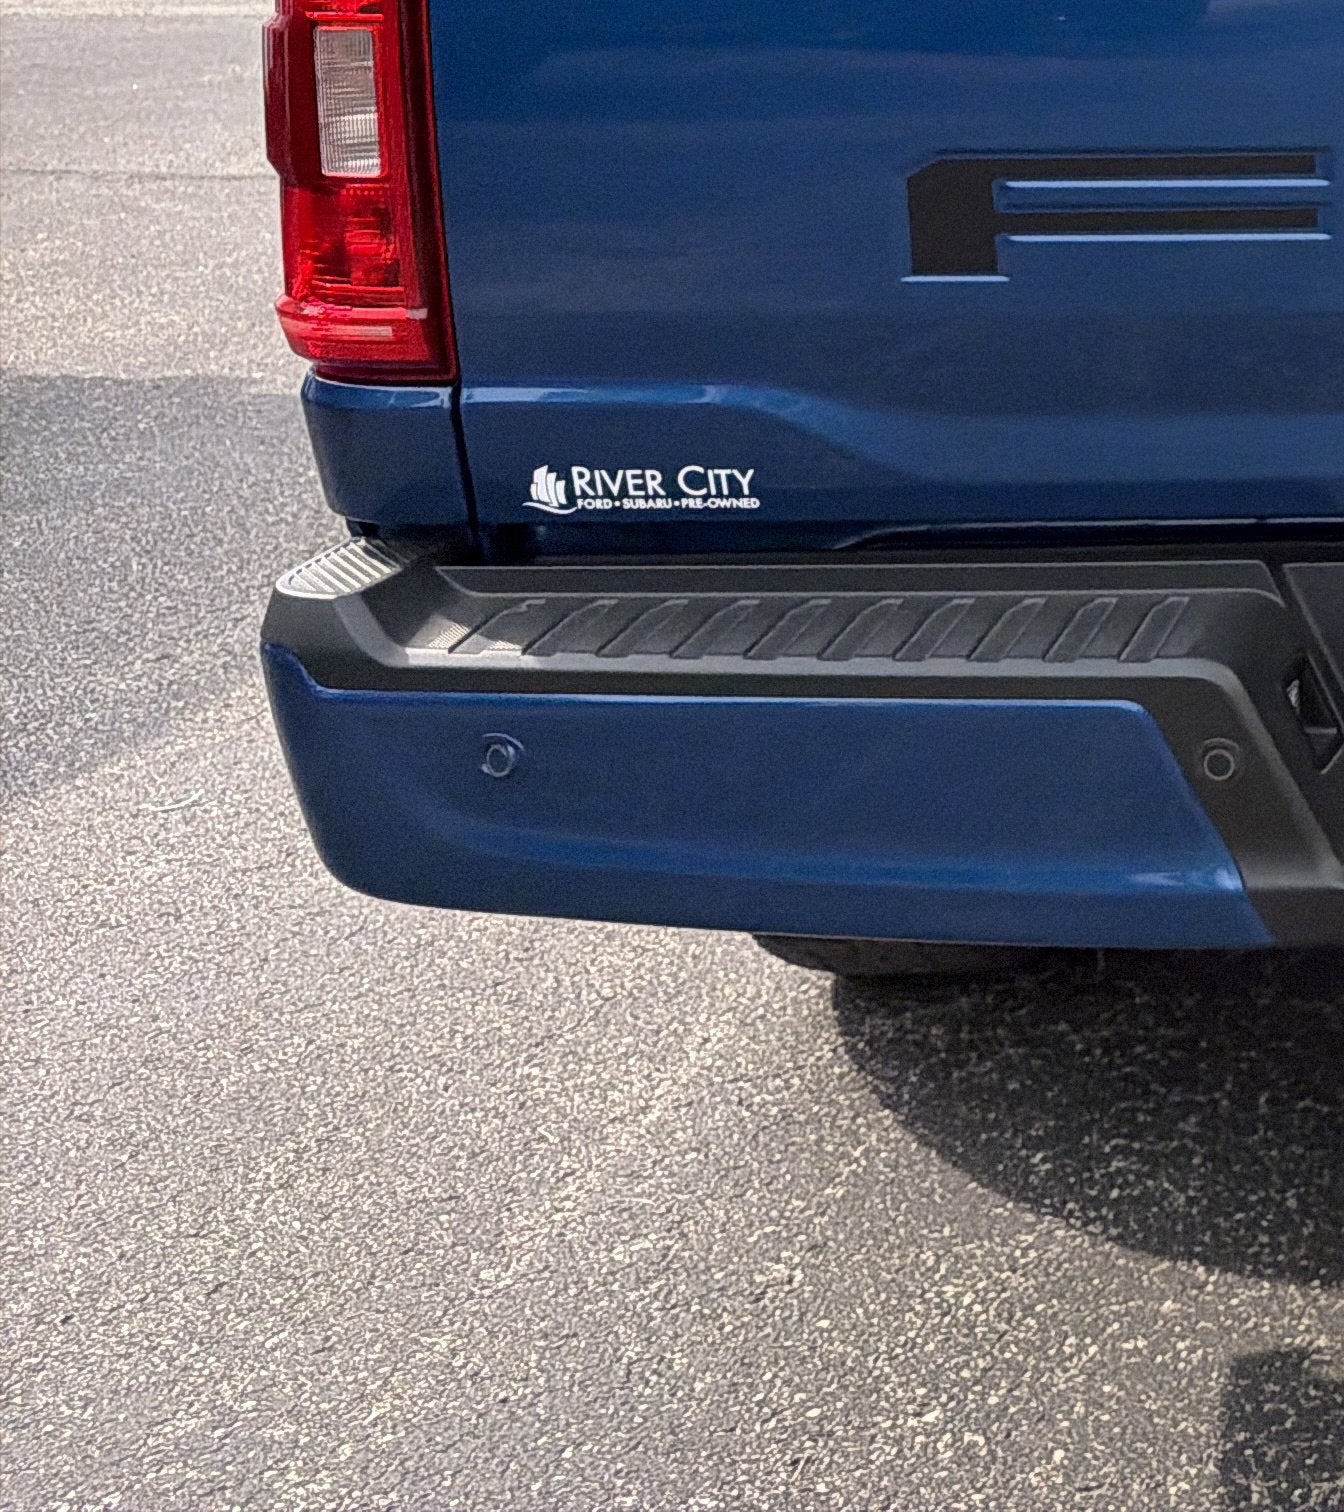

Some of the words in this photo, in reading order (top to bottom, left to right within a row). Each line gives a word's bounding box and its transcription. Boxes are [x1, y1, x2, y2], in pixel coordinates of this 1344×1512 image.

[571, 465, 666, 497] RIVER
[677, 465, 755, 496] CITY
[577, 498, 612, 510] FORD
[681, 498, 760, 510] PRE-OWNED
